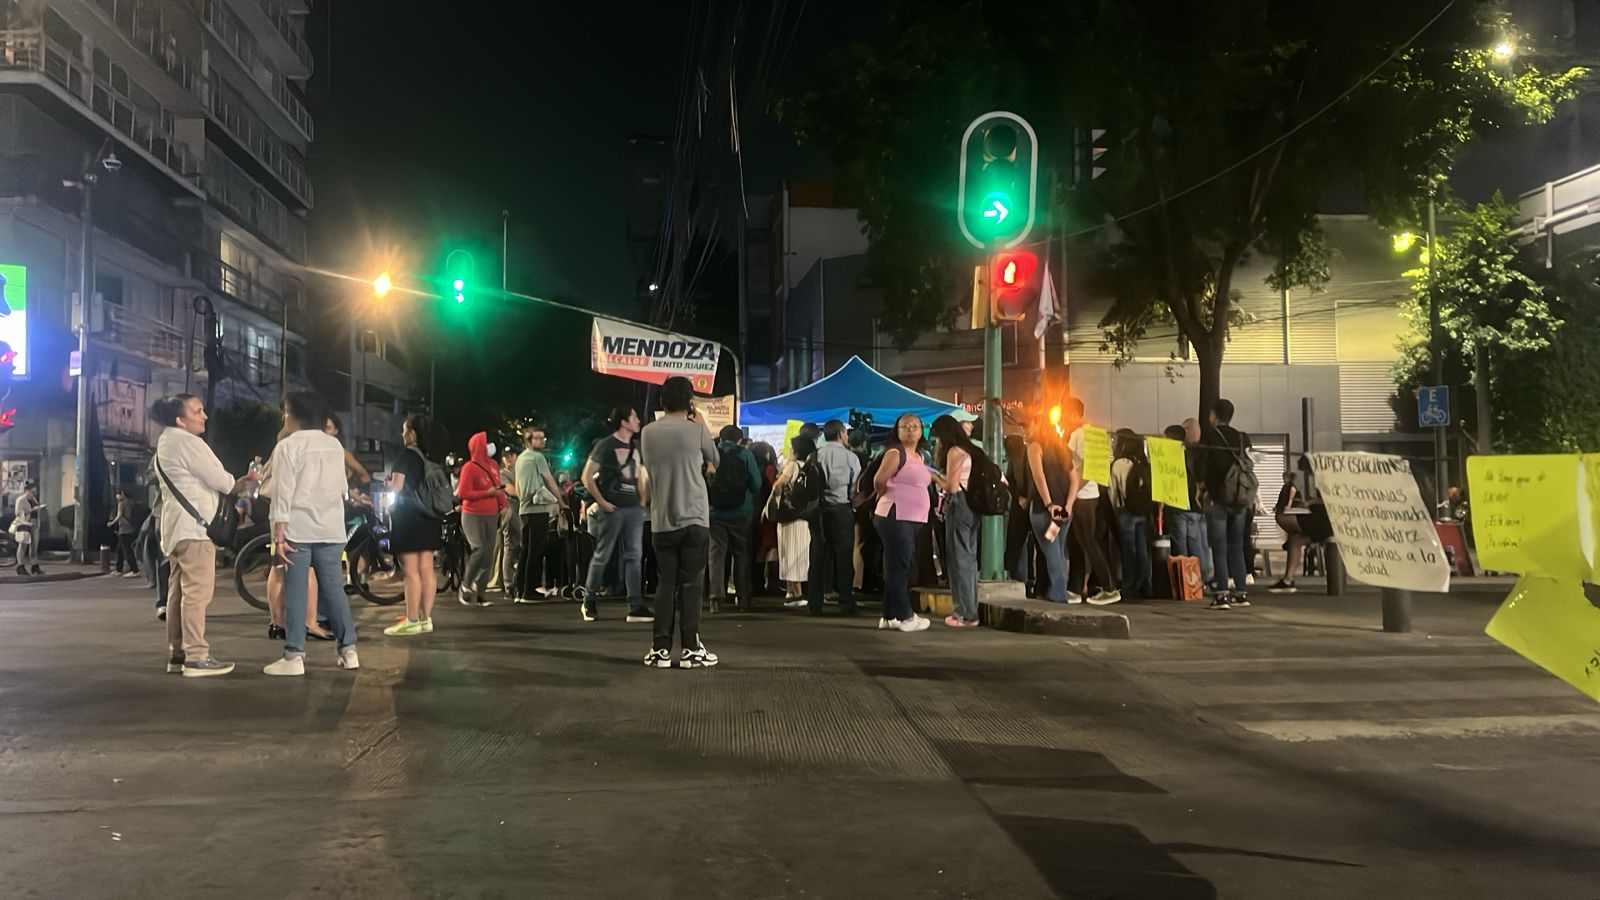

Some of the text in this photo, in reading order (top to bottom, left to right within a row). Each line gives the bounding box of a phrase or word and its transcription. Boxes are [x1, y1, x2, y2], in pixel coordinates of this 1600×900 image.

[602, 335, 716, 362] MENDOZA
[604, 355, 647, 366] LCALDE
[652, 360, 715, 371] BENITO JUÁREZ
[1429, 389, 1437, 402] E
[1366, 544, 1402, 562] daños
[1406, 551, 1417, 563] a
[1419, 547, 1437, 564] la
